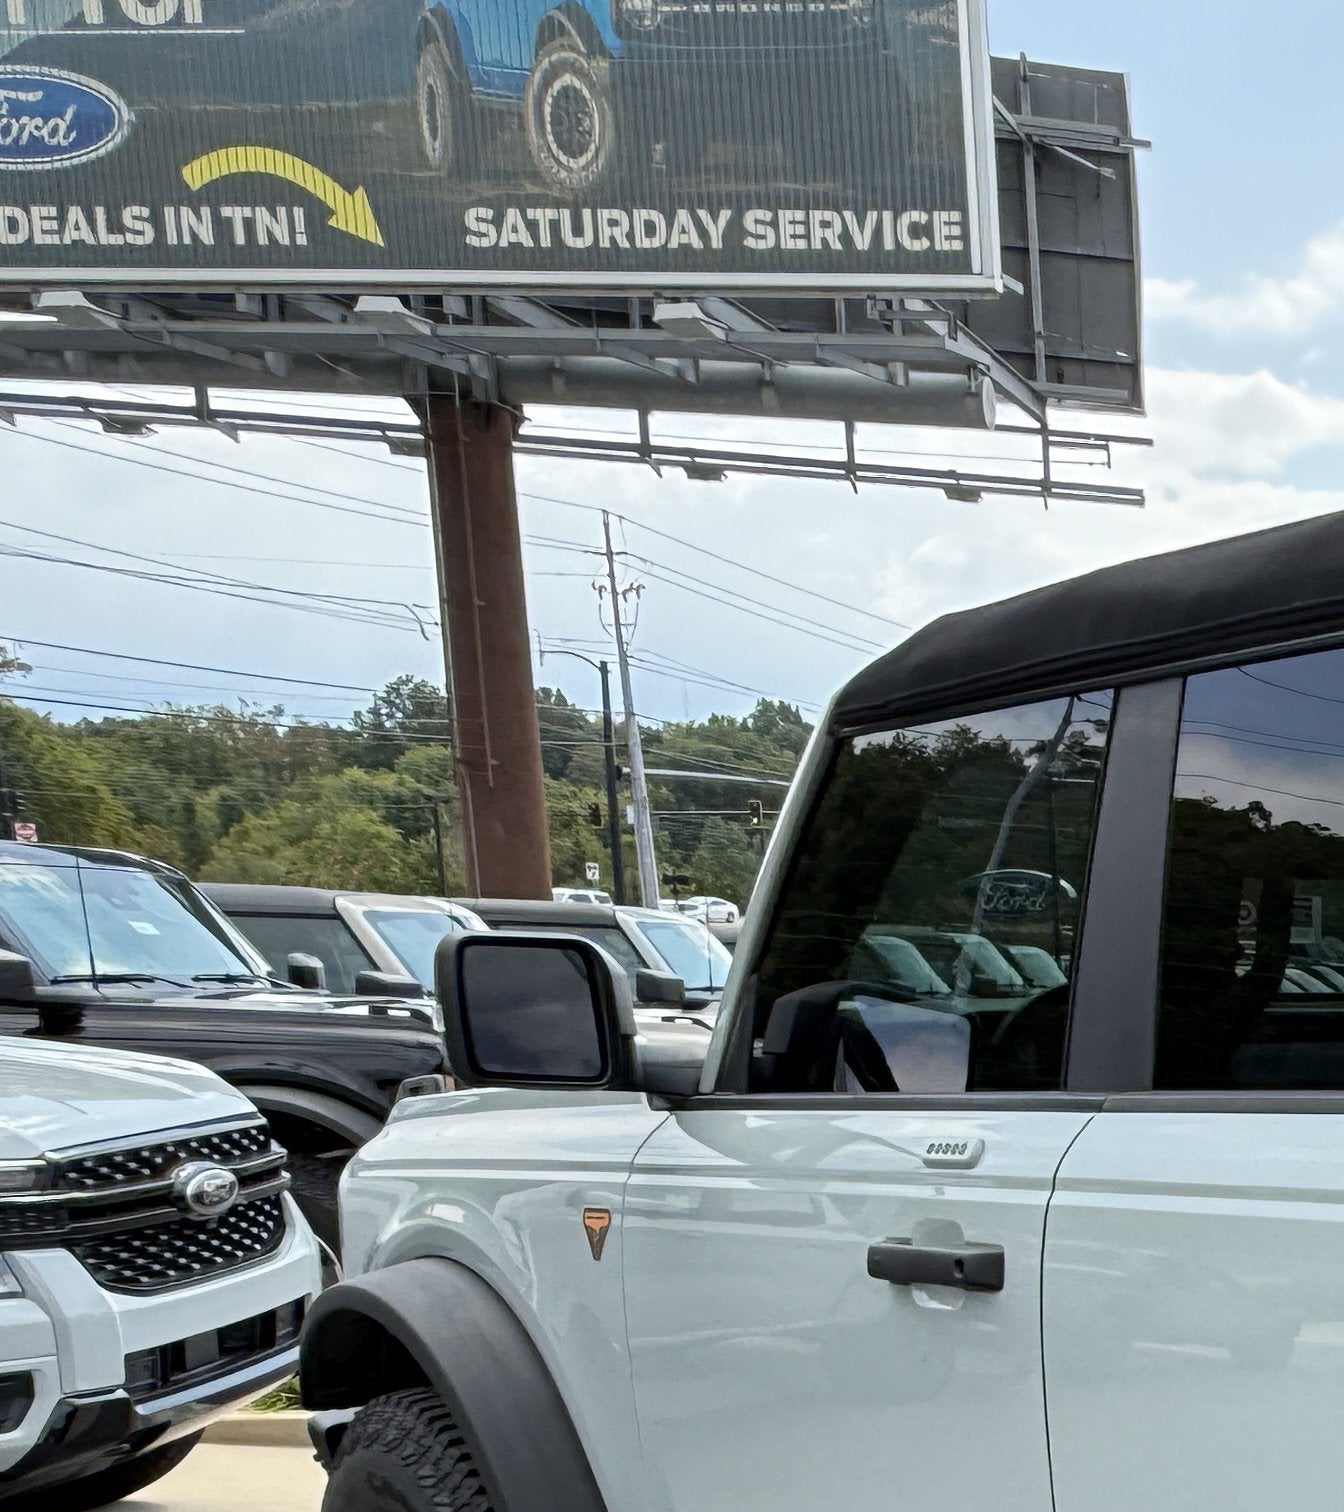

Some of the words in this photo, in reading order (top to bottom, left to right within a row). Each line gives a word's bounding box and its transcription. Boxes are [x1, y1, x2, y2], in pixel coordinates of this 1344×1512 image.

[0, 205, 155, 246] DEALS
[163, 206, 214, 246] IN
[220, 206, 308, 246] TN!
[464, 207, 732, 249] SATURDAY
[742, 209, 964, 251] SERVICE
[980, 878, 1047, 911] Ford
